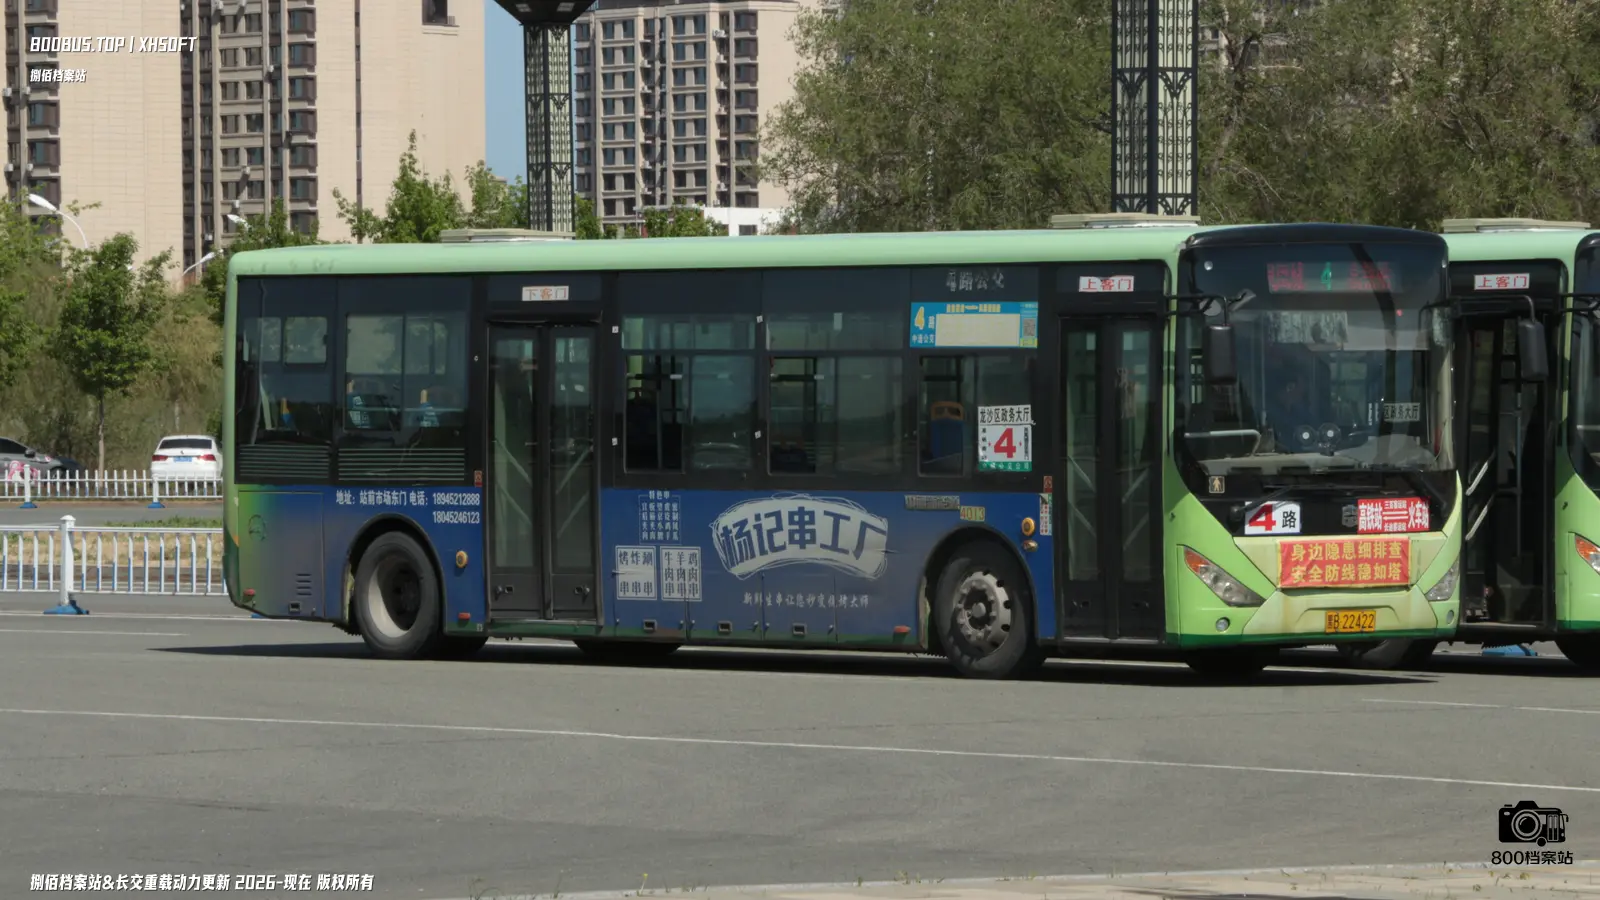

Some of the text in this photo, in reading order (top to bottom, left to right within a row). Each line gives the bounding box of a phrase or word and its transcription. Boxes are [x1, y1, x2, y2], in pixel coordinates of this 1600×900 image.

[1082, 278, 1132, 291] 上客门
[1321, 261, 1332, 291] 4
[1477, 275, 1527, 288] 上客门
[525, 287, 567, 300] 下客门
[914, 306, 925, 331] 4
[980, 407, 1030, 424] 龙沙区政务大厅
[993, 427, 1017, 459] 4
[432, 510, 480, 524] 18045246123
[1248, 503, 1297, 532] 4 路
[1358, 502, 1383, 532] 高铁站
[1407, 500, 1429, 529] 火车站
[719, 506, 887, 569] 杨记串工厂
[1290, 541, 1402, 561] 身边隐患细排查
[1290, 563, 1402, 584] 安全防线稳如塔
